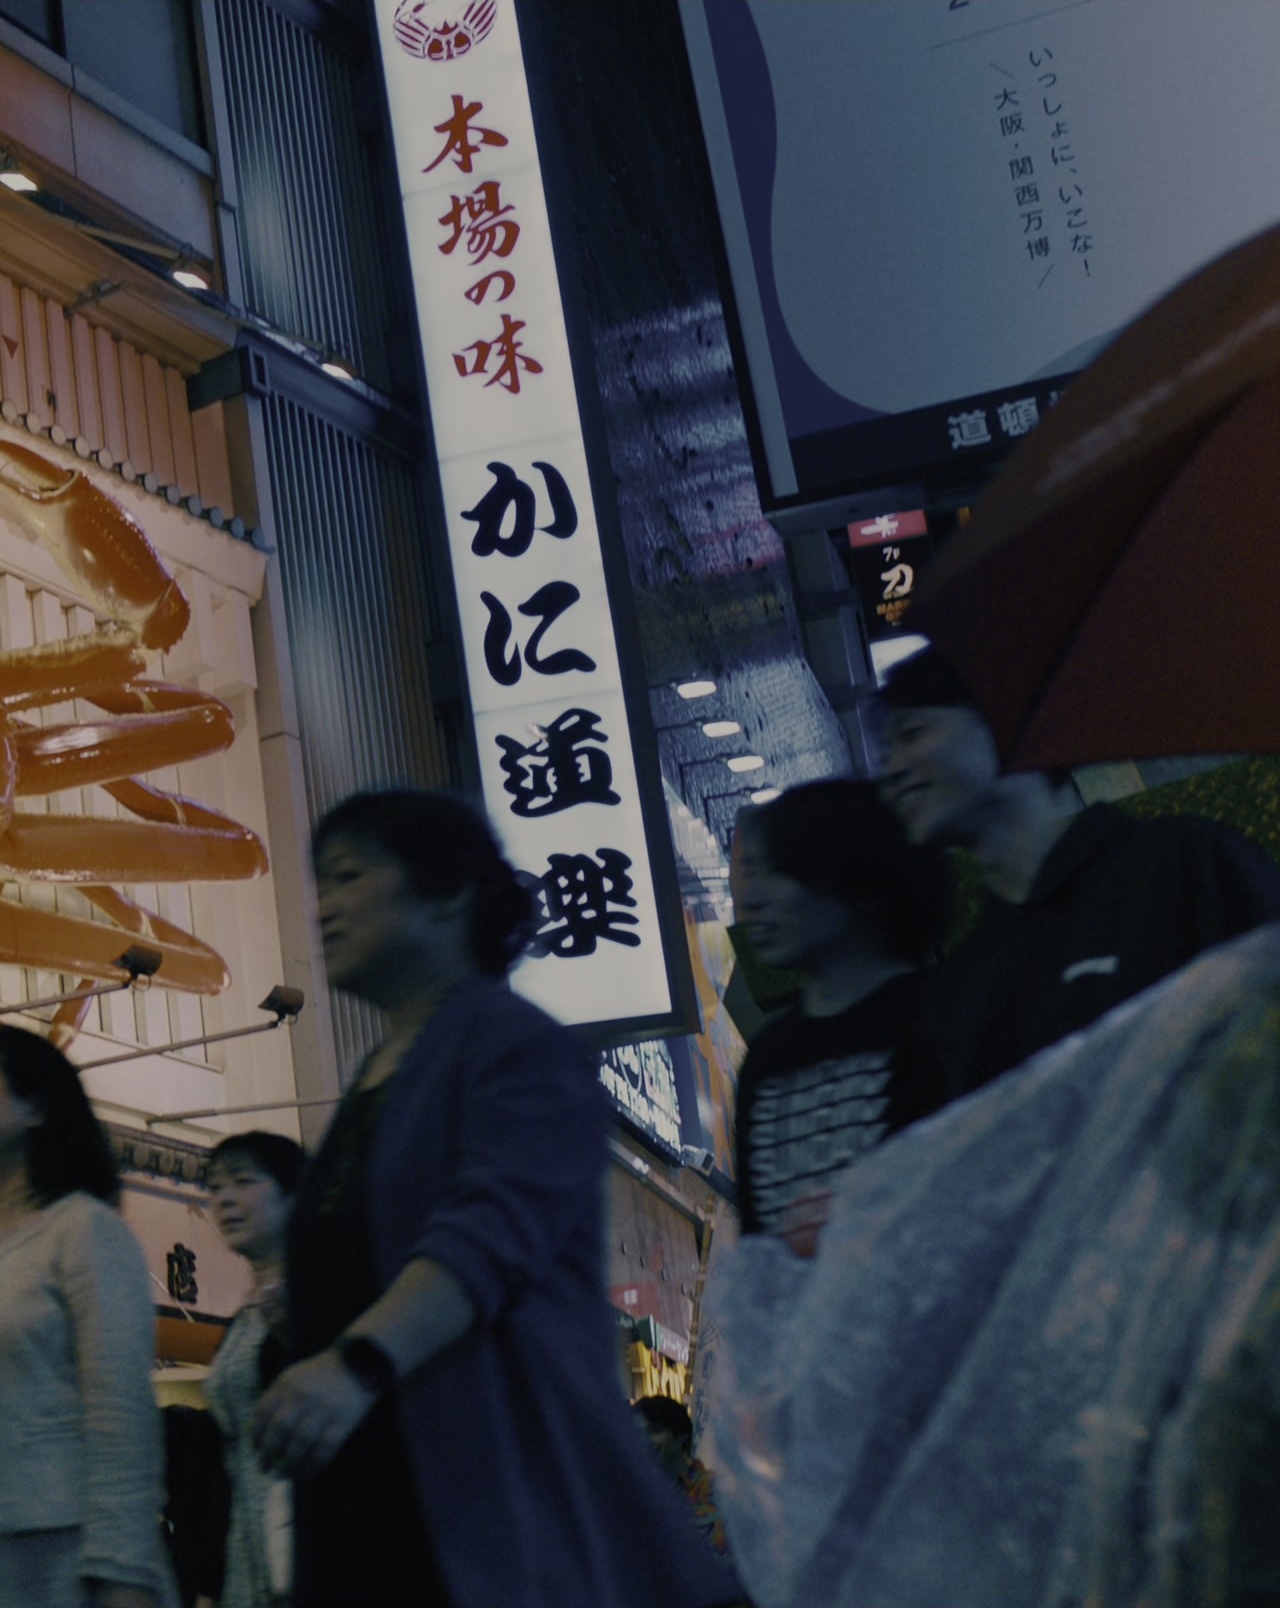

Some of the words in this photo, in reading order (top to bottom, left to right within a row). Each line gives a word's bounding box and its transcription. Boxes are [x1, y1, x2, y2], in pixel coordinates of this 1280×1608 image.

[422, 95, 544, 394] 本場の味
[994, 86, 1051, 261] 大阪・関西万博
[947, 390, 1064, 450] 道頓
